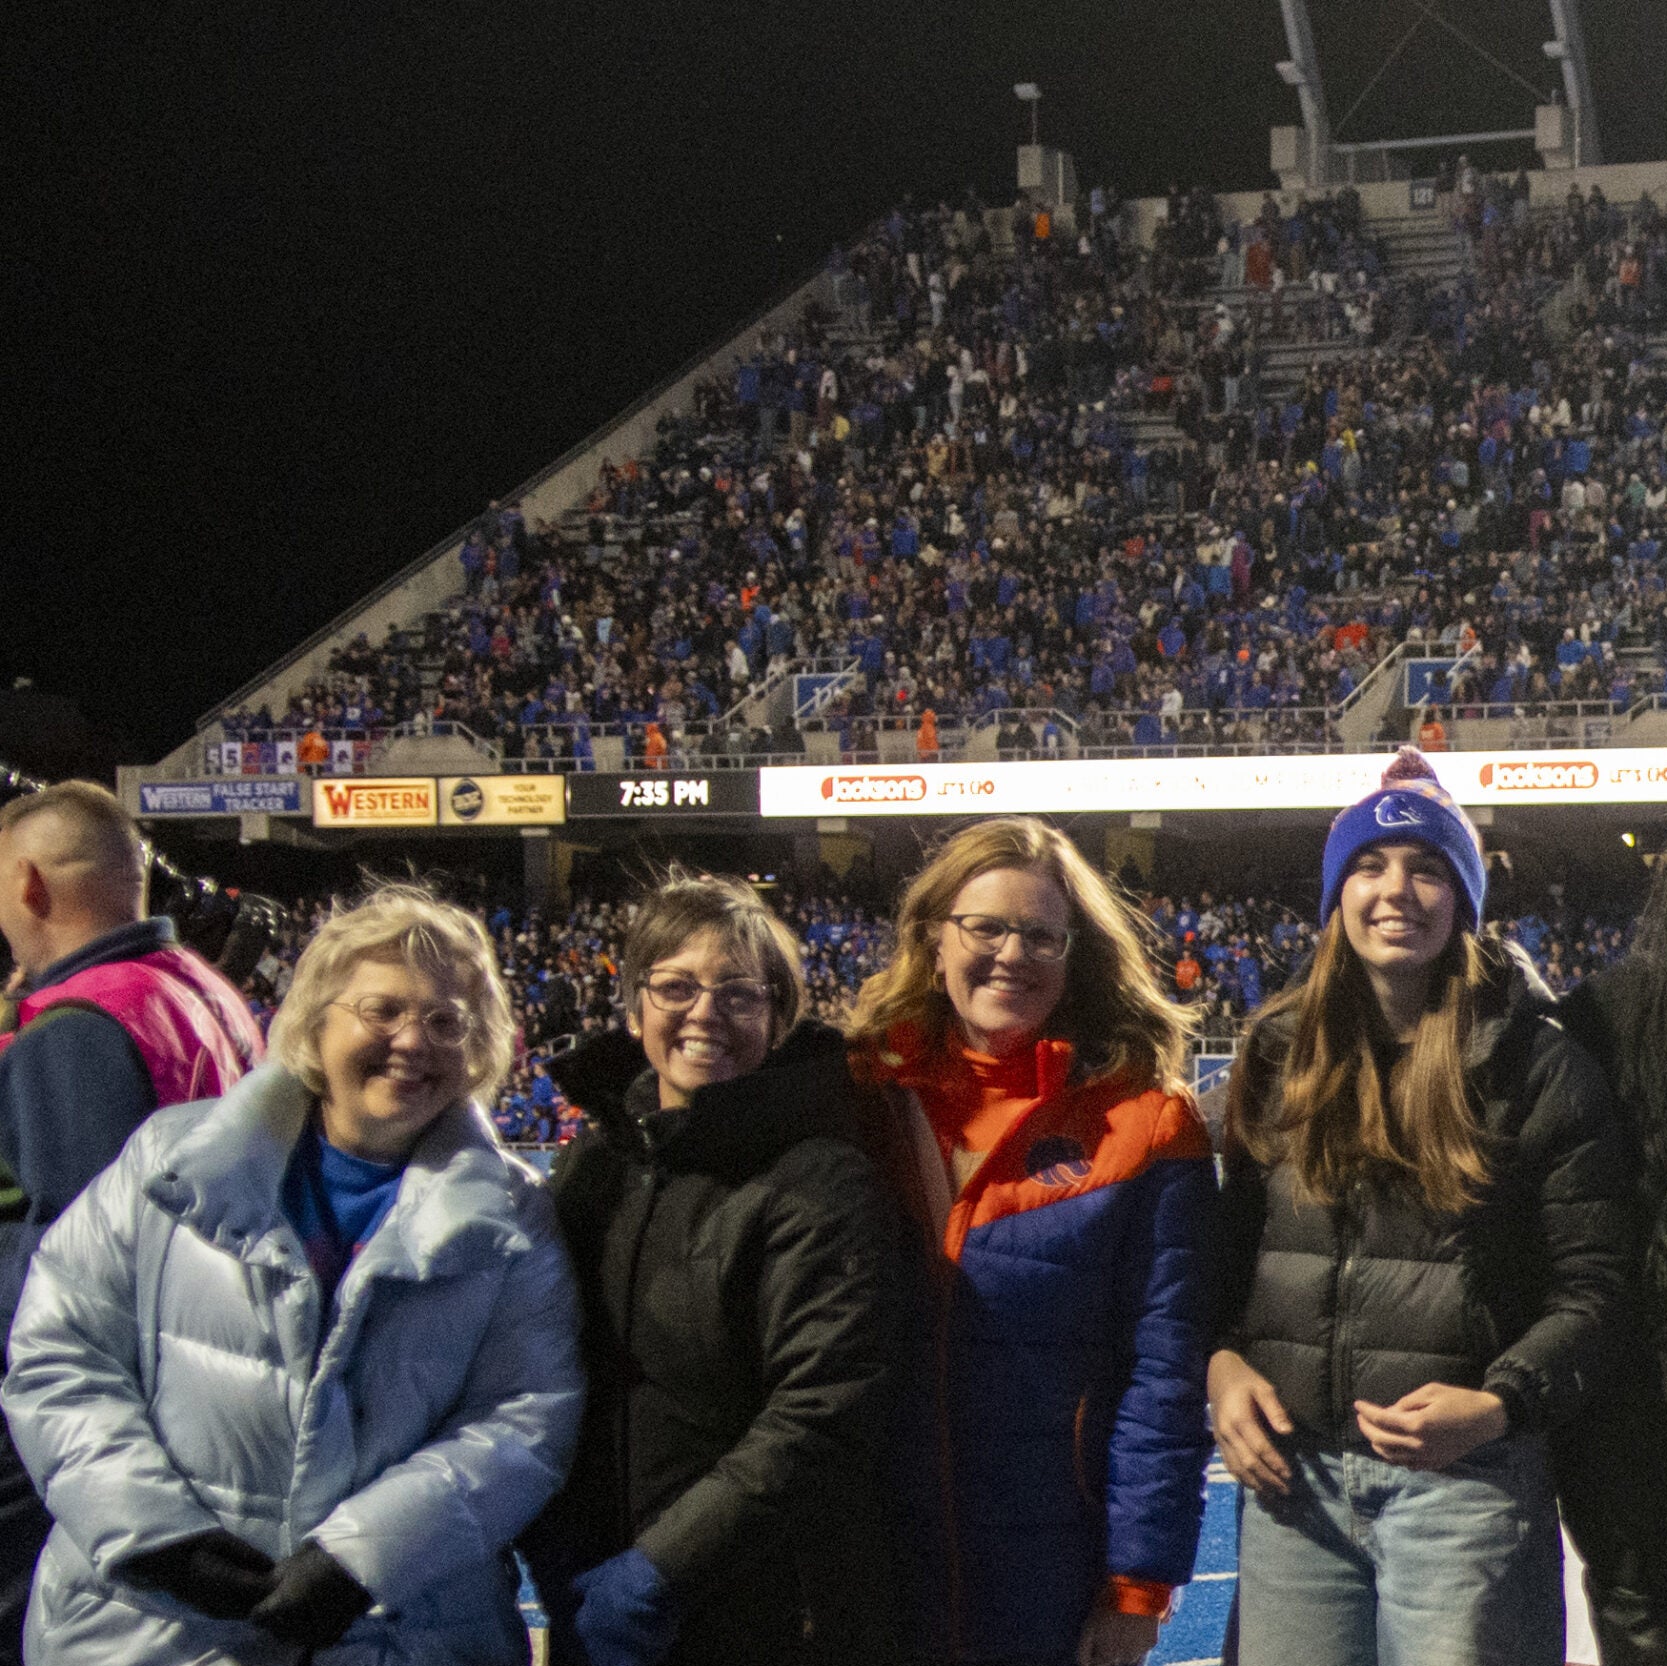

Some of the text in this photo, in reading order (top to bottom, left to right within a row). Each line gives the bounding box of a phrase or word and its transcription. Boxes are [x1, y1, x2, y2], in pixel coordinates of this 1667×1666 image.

[825, 775, 924, 802] Jacksons
[1484, 762, 1595, 790] Jacksons
[213, 783, 296, 796] FALSE START
[324, 785, 429, 818] WESTERN
[620, 780, 708, 806] 7:35 PM
[225, 798, 284, 811] TRACKER
